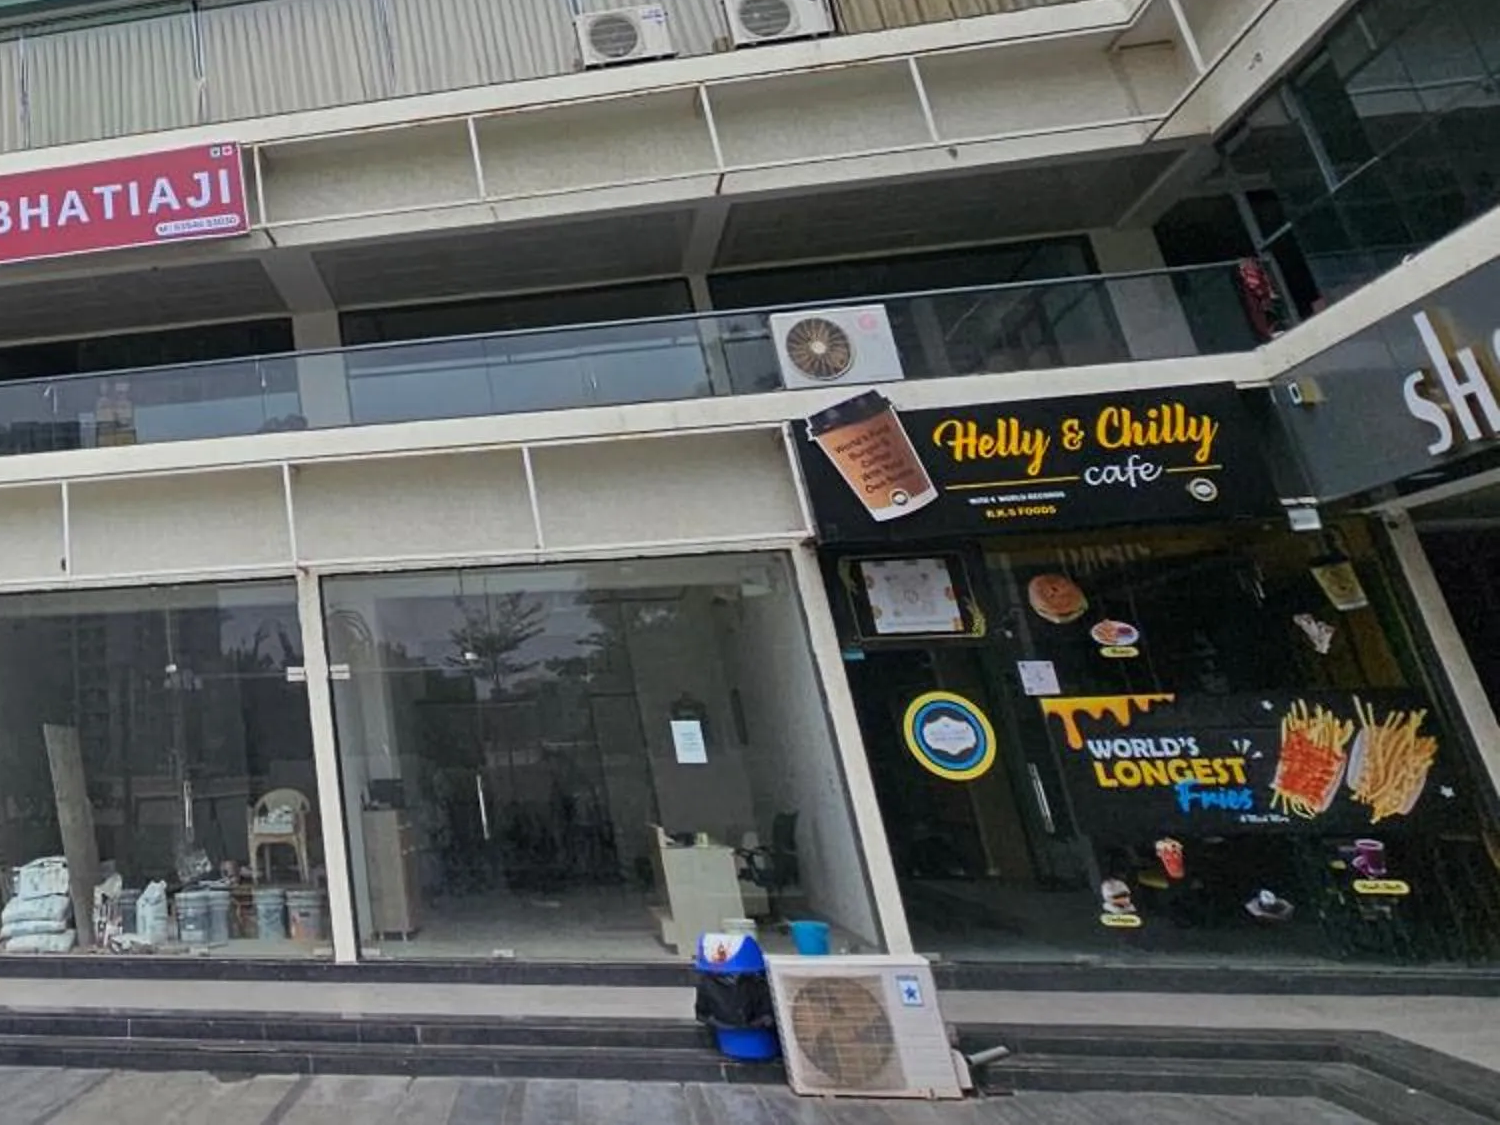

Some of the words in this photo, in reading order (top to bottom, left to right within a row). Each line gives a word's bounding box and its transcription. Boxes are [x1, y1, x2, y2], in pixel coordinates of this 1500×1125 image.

[1403, 310, 1500, 456] SH
[932, 417, 1051, 476] Helly
[1062, 418, 1086, 451] &
[1096, 403, 1219, 463] Chilly
[1084, 454, 1163, 488] cafe
[1018, 504, 1057, 516] FOODS
[1087, 736, 1200, 759] WORLD'S
[1092, 757, 1248, 788] LONGEST
[1174, 779, 1253, 813] Fries
